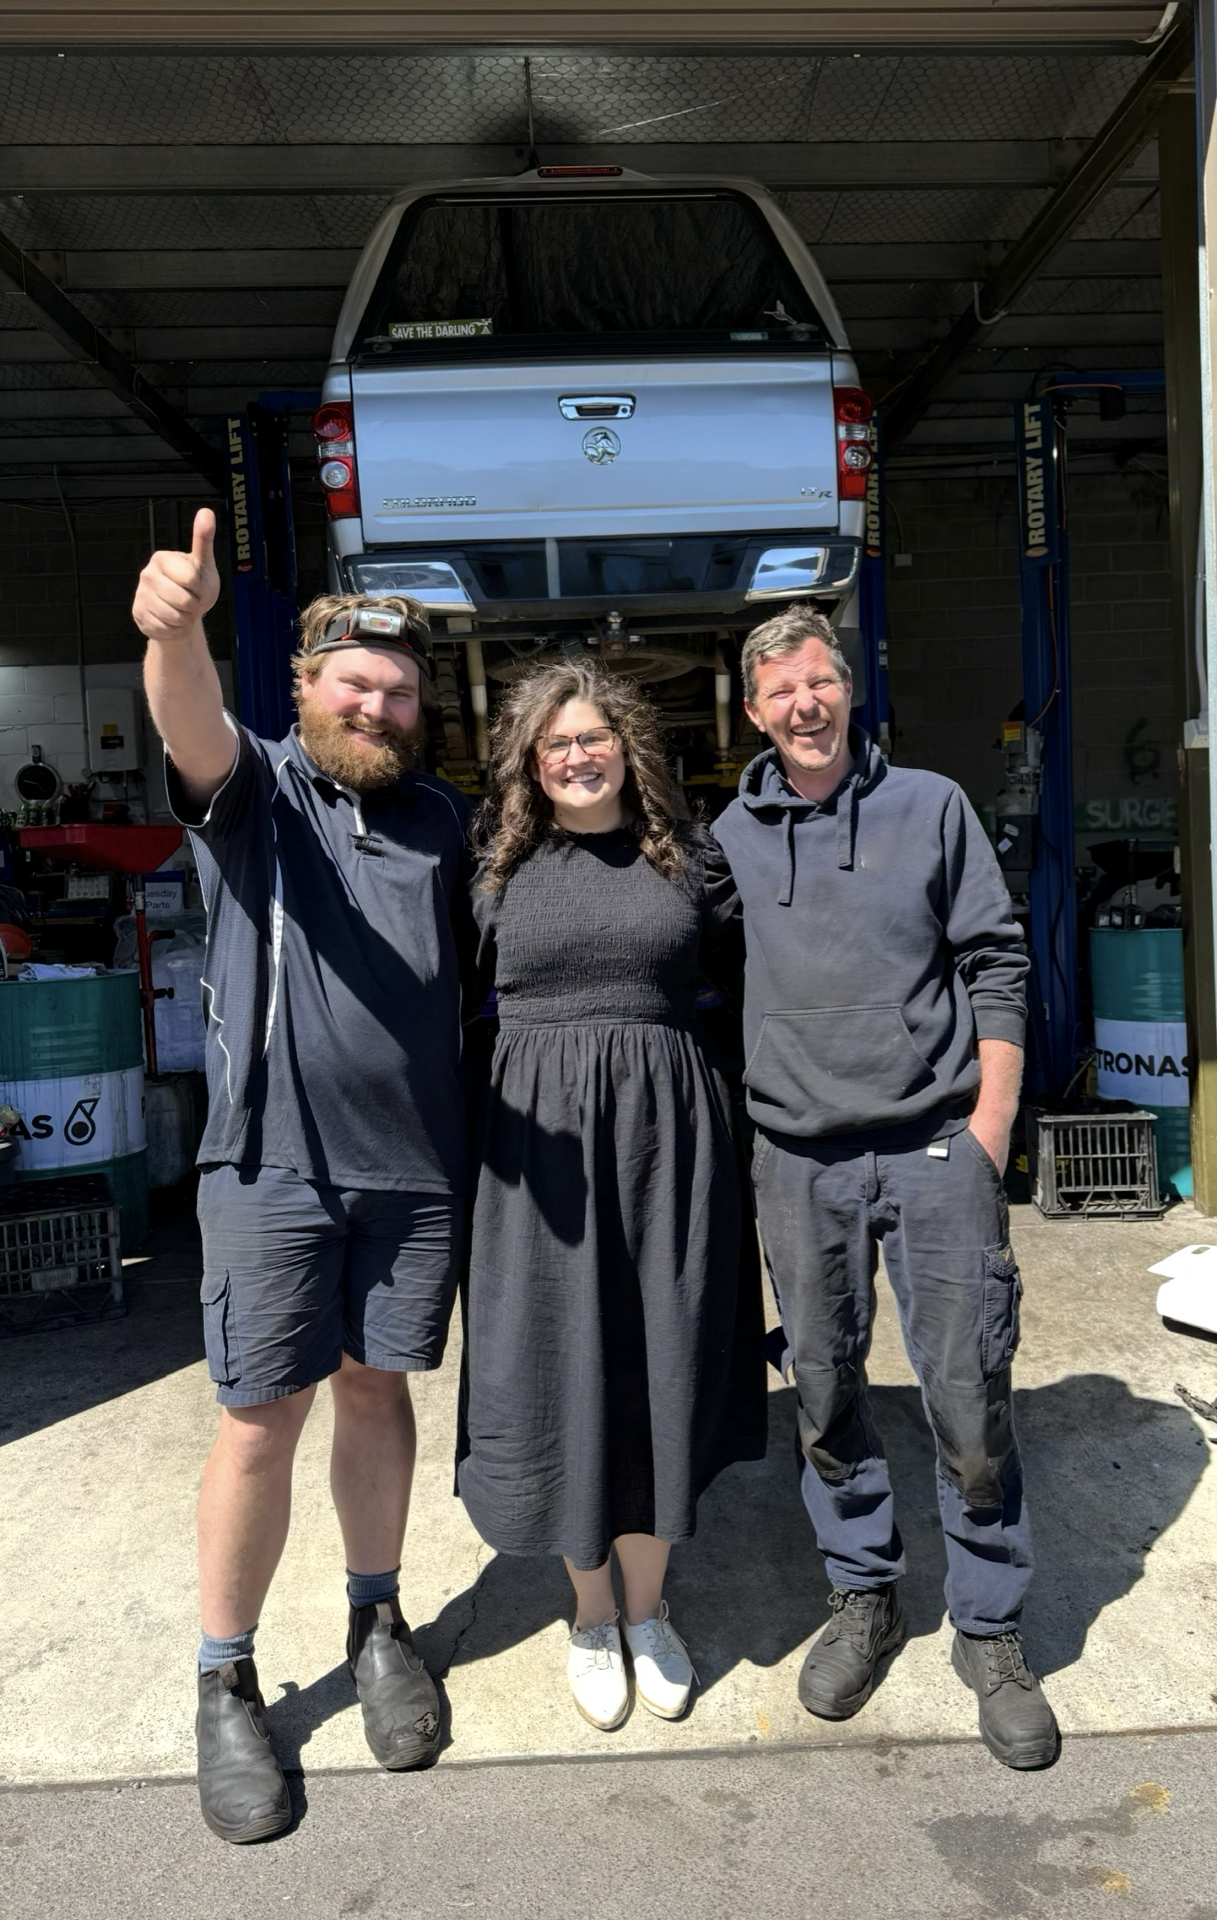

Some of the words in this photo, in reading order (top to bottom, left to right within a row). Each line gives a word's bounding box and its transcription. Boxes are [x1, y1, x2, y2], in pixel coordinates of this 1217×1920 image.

[391, 327, 414, 339] SAVE
[416, 325, 433, 338] THE
[435, 324, 476, 337] DARLING
[227, 417, 244, 466] LIFT
[1023, 403, 1043, 451] LIFT
[231, 472, 251, 561] ROTARY
[382, 496, 477, 509] COLORADO
[867, 464, 881, 547] ROTARY
[1025, 455, 1047, 546] ROTARY
[145, 889, 178, 900] uesday
[146, 901, 171, 909] Parts
